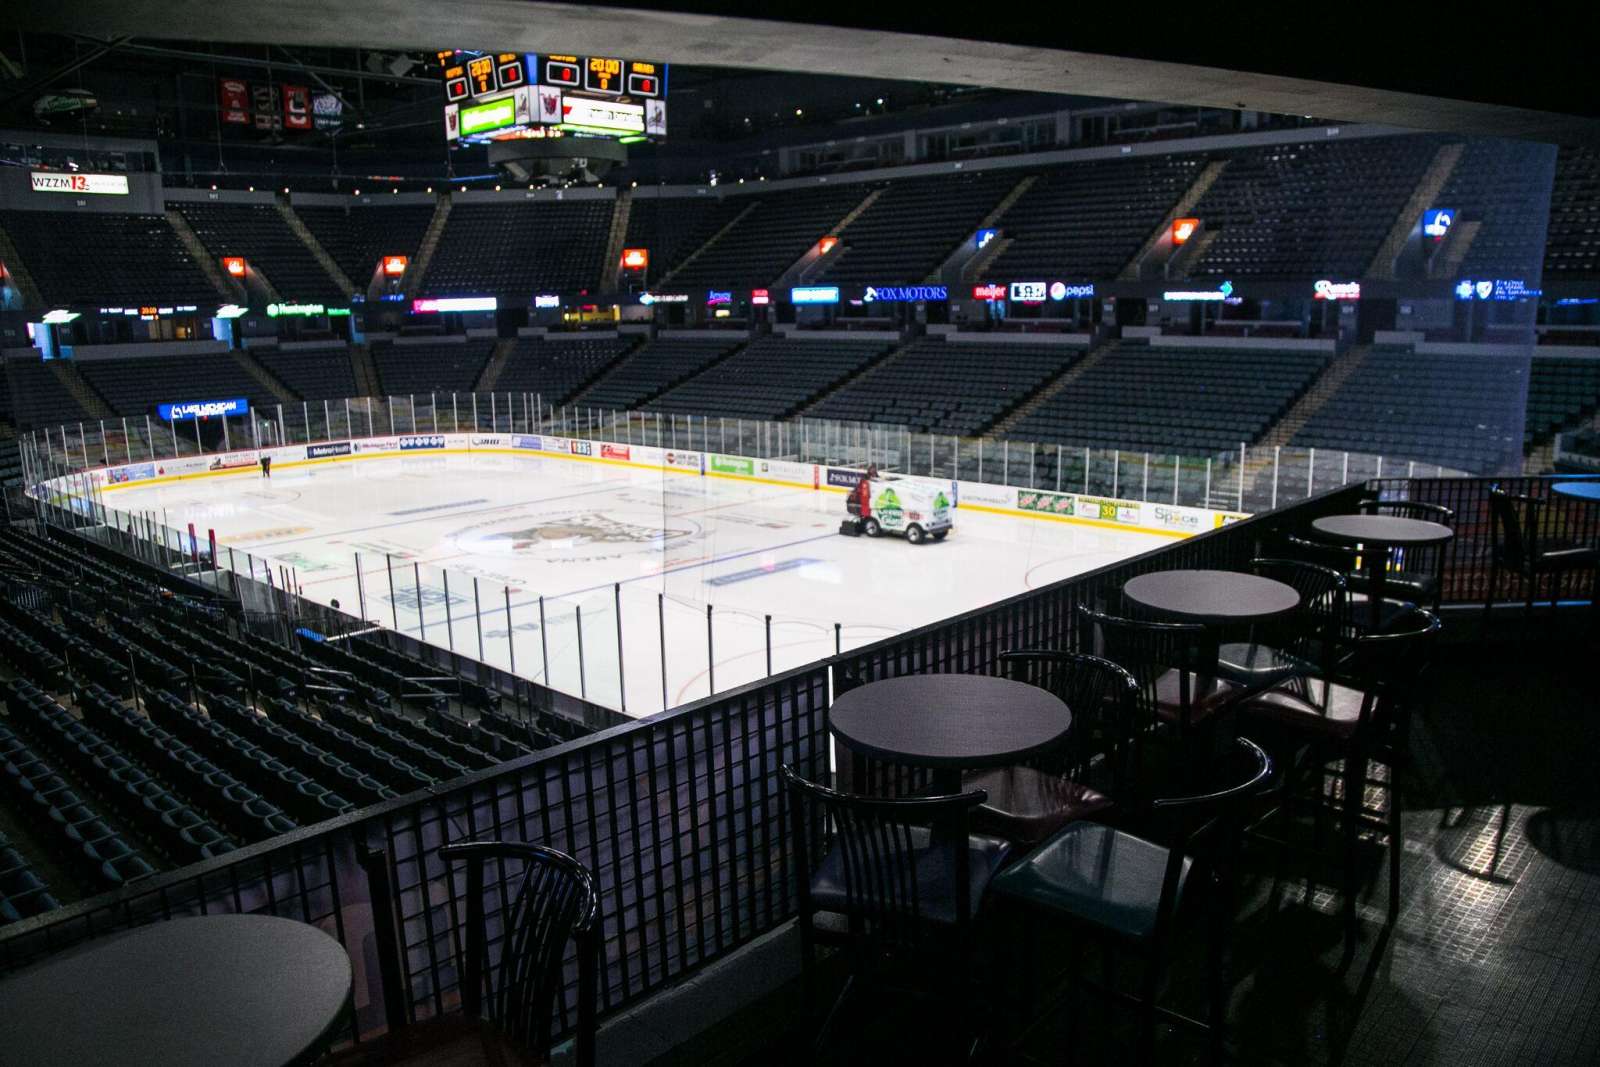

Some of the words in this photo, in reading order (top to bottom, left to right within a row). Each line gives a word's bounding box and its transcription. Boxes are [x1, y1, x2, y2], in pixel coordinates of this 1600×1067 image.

[876, 287, 897, 300] FOX
[899, 286, 948, 300] MOTORS
[975, 284, 1006, 299] meijer
[1066, 284, 1094, 298] pepsi
[1102, 506, 1115, 517] 30
